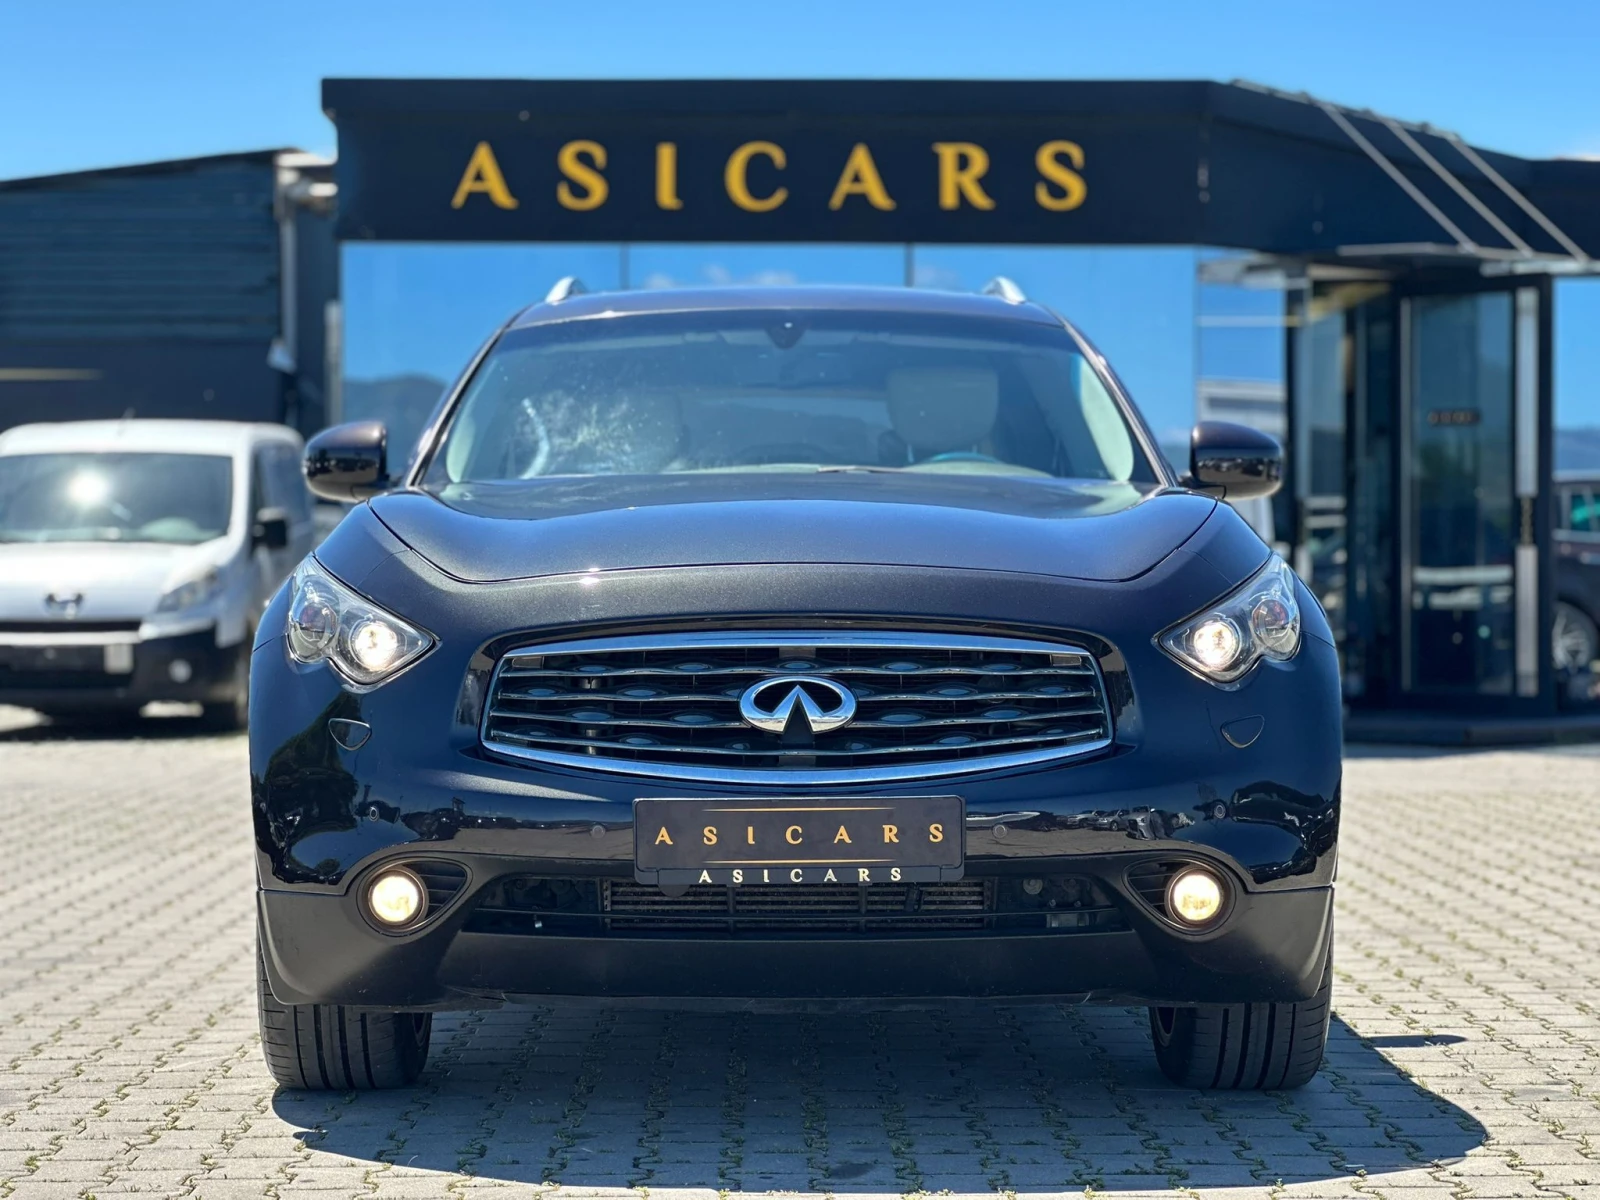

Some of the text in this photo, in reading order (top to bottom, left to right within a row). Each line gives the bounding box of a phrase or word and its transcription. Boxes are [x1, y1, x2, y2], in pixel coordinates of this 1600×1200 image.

[451, 140, 1088, 211] ASICARS
[655, 823, 944, 845] ASICARS
[698, 867, 902, 884] ASICARS
